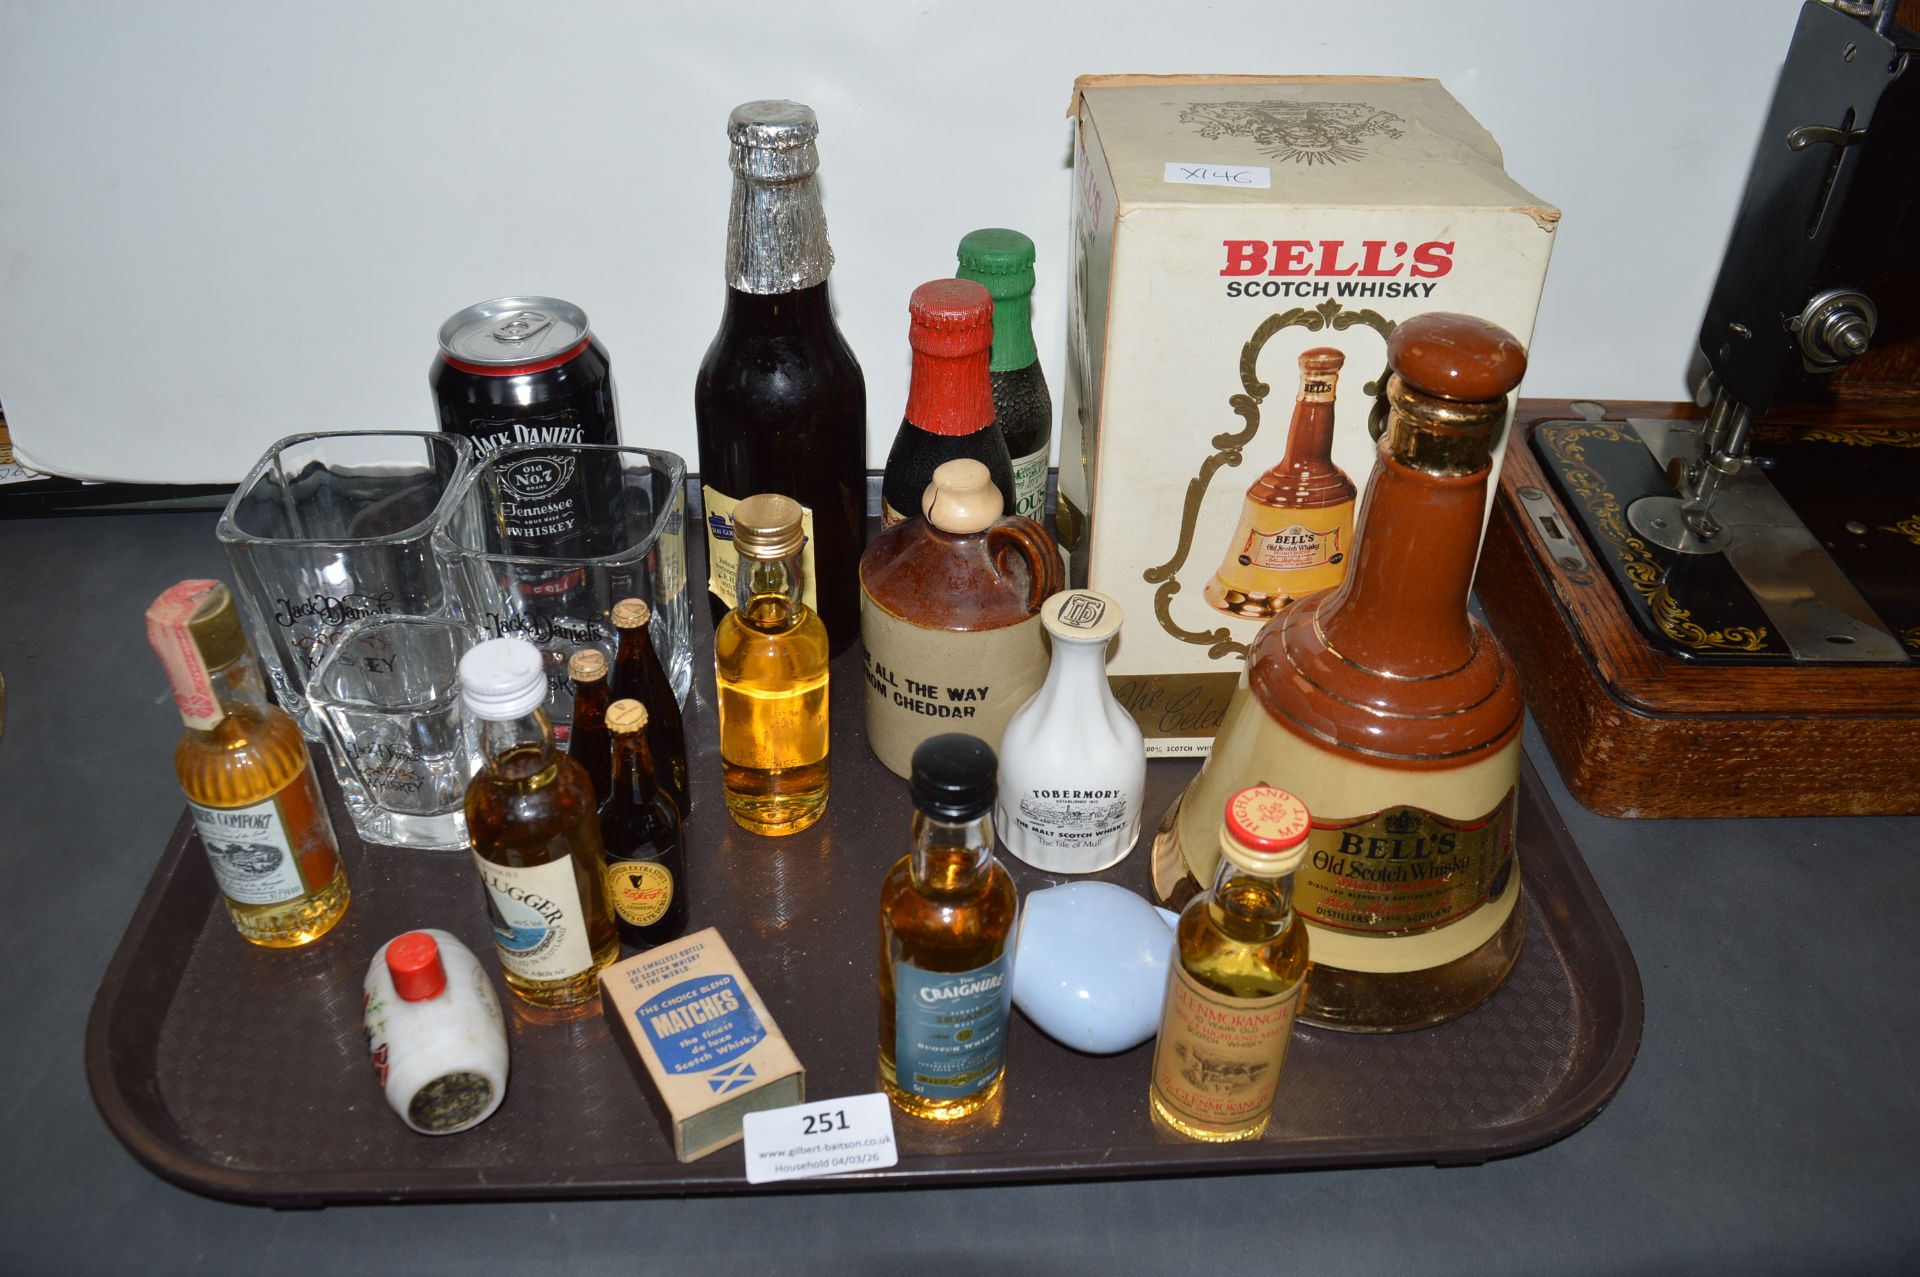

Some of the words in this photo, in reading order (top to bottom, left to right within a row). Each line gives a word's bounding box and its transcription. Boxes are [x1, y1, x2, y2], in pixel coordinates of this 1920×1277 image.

[1219, 239, 1455, 279] BELL'S
[1226, 281, 1330, 298] SCOTCH
[1336, 281, 1438, 298] WHISKY
[470, 432, 512, 460] JACK
[522, 464, 543, 474] Old
[509, 518, 576, 538] WHISKEY
[1275, 534, 1315, 545] BELL'S
[275, 597, 325, 627] Jack
[316, 592, 394, 627] Daniel's
[485, 612, 529, 638] Jack
[526, 612, 603, 645] Daniel's
[875, 662, 898, 688] ALL
[905, 678, 939, 700] THE
[946, 686, 990, 701] WAY
[1032, 790, 1120, 799] TOBERMORY
[216, 812, 273, 830] COMFORT
[1235, 789, 1290, 832] HIGHLAND
[1278, 807, 1305, 837] MALT
[1016, 817, 1029, 829] THE
[1032, 826, 1054, 836] MALT
[1095, 822, 1126, 836] WHISKY
[1038, 837, 1054, 847] The
[1056, 839, 1070, 849] Isle
[1072, 840, 1081, 849] of
[1083, 838, 1103, 848] Mull
[1337, 830, 1457, 860] BELL'S
[1312, 850, 1347, 877] Old
[1346, 861, 1409, 883] Scotch
[1411, 855, 1470, 881] Whisky
[482, 871, 563, 925] LUGGER
[1308, 881, 1344, 896] DISTILLED
[1316, 907, 1369, 923] DISTILLERS
[1407, 906, 1453, 923] SCOTLAND
[626, 967, 640, 978] THE
[642, 954, 679, 972] SMALLEST
[680, 943, 705, 957] BOTTLE
[641, 964, 672, 979] SCOTCH
[673, 953, 701, 969] WHISKY
[638, 1005, 659, 1017] THE
[661, 990, 698, 1009] CHOICE
[699, 977, 730, 994] BLEND
[920, 974, 1004, 1003] CRAIGNURE
[650, 988, 740, 1039] MATCHES
[1175, 984, 1291, 1027] GLENMORANGIE
[680, 1037, 699, 1049] the
[702, 1022, 734, 1040] finest
[1187, 1026, 1220, 1045] SCOTCH
[1202, 1028, 1257, 1041] HIGHLAND
[1208, 1021, 1237, 1033] YEARS
[674, 1053, 713, 1073] Scotch
[716, 1034, 758, 1056] Whisky
[691, 1045, 705, 1054] de
[708, 1034, 732, 1048] luxe
[802, 1110, 850, 1135] 251
[758, 1135, 892, 1160] www.gilbert-baitson.co.uk
[774, 1159, 829, 1174] Household
[831, 1153, 880, 1169] 04/03/26
